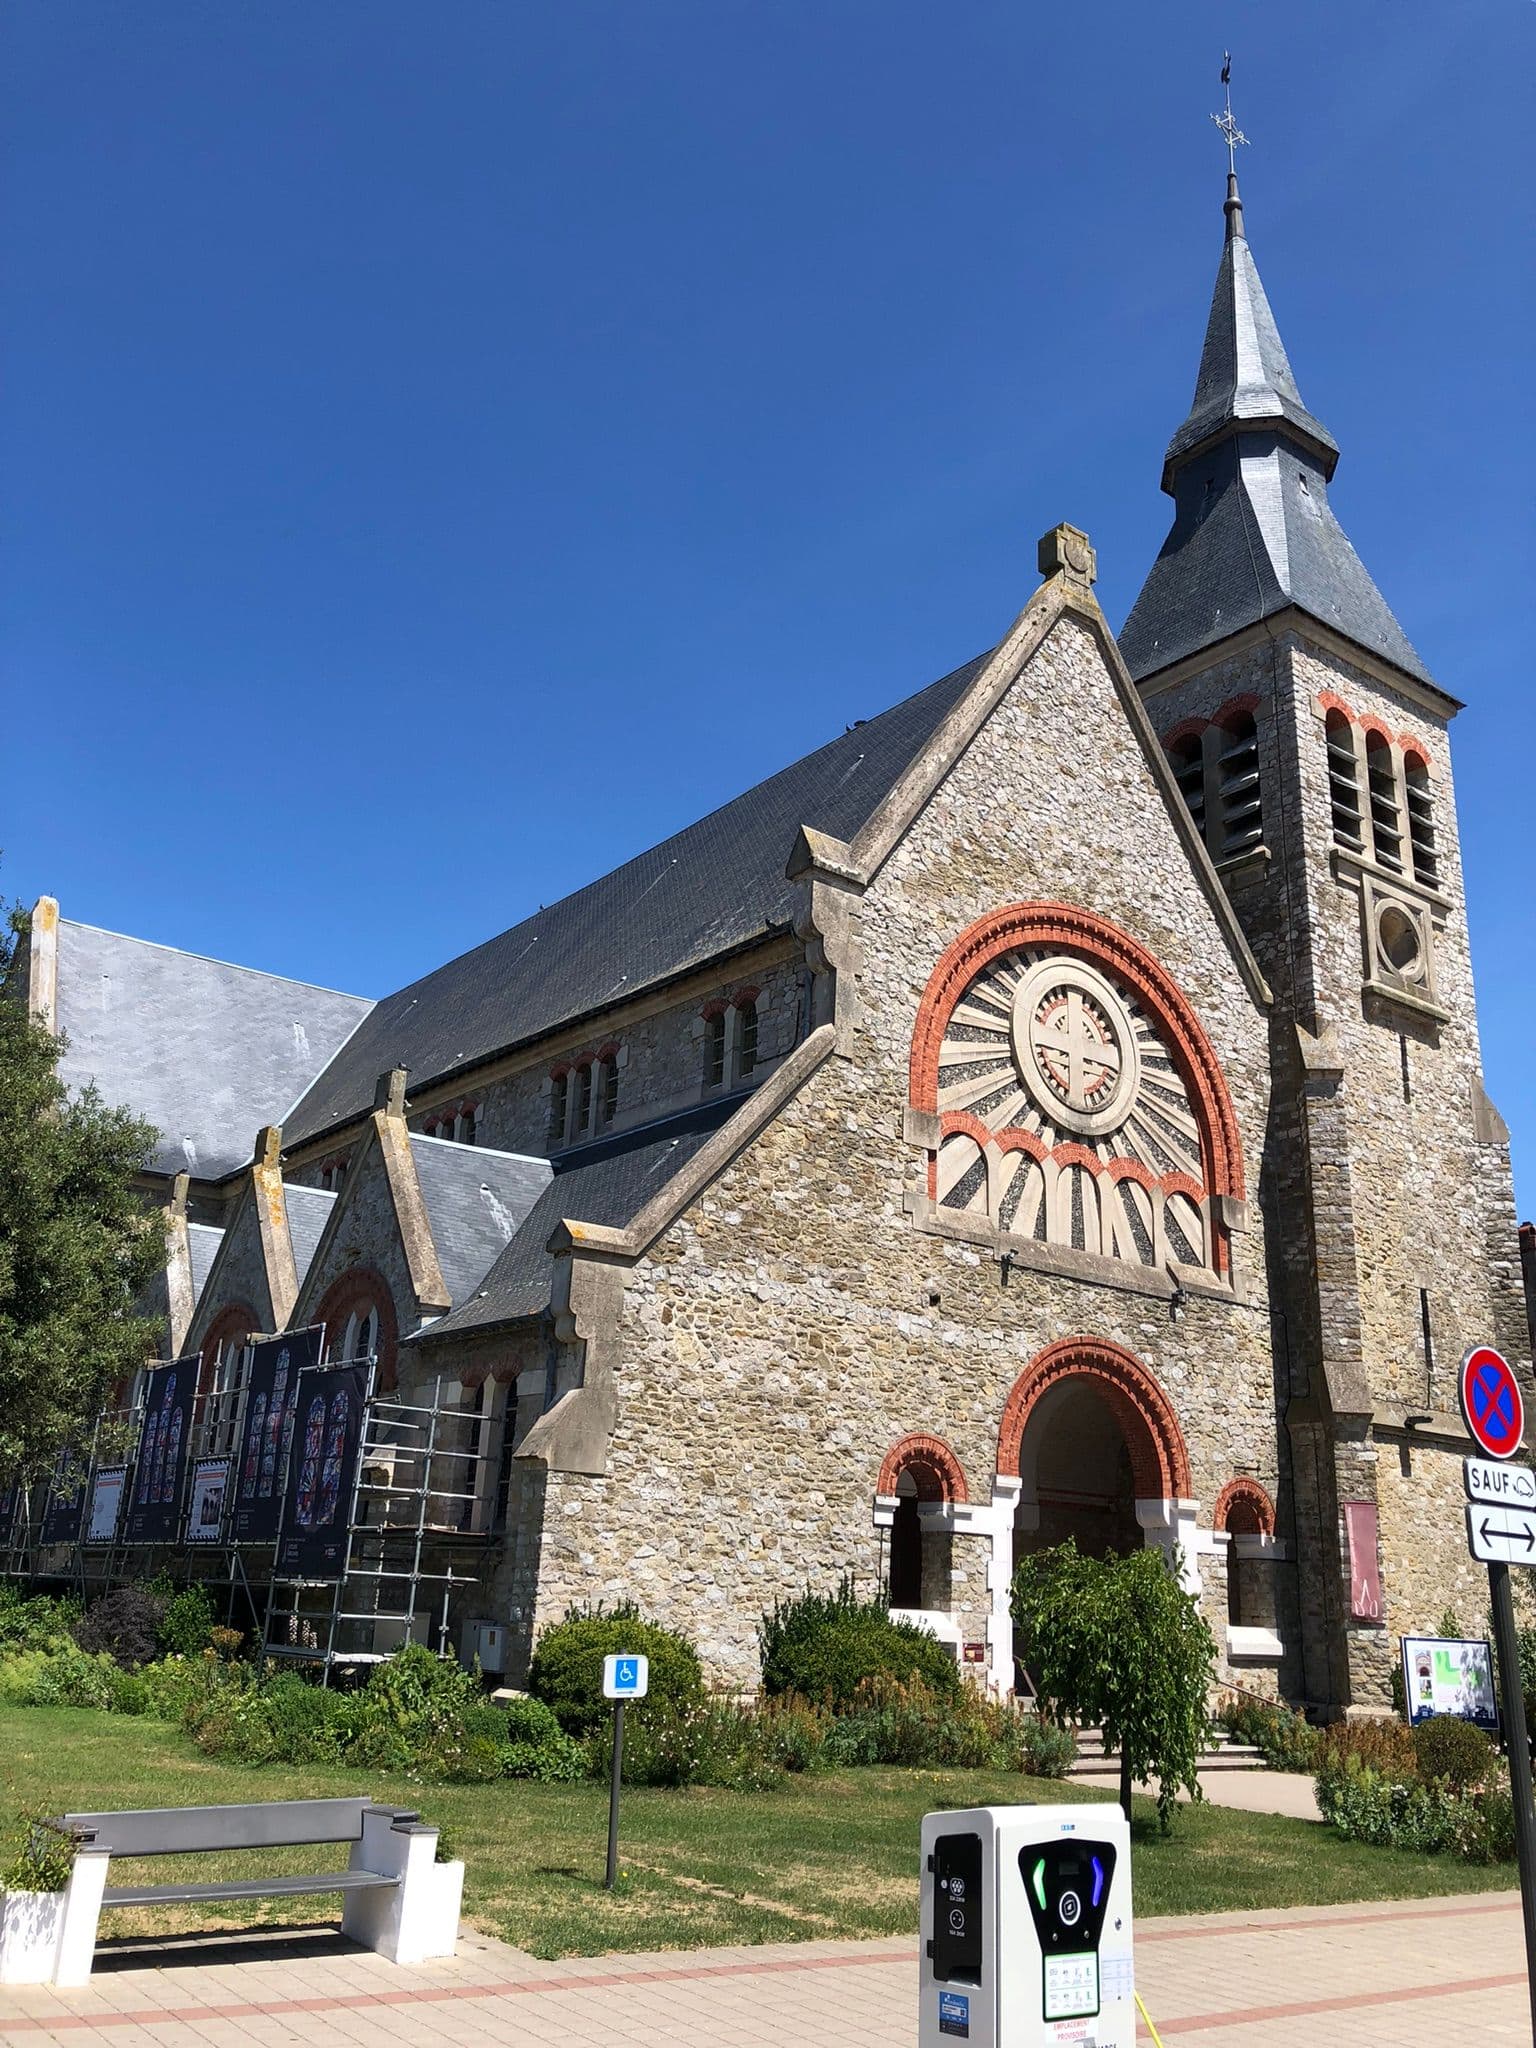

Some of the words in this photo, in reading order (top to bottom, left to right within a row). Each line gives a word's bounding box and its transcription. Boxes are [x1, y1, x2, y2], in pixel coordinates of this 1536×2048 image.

[1471, 1467, 1509, 1494] SAUF
[1053, 2018, 1089, 2030] EMPLACEMENT
[1057, 2030, 1086, 2040] PROVISOIRE
